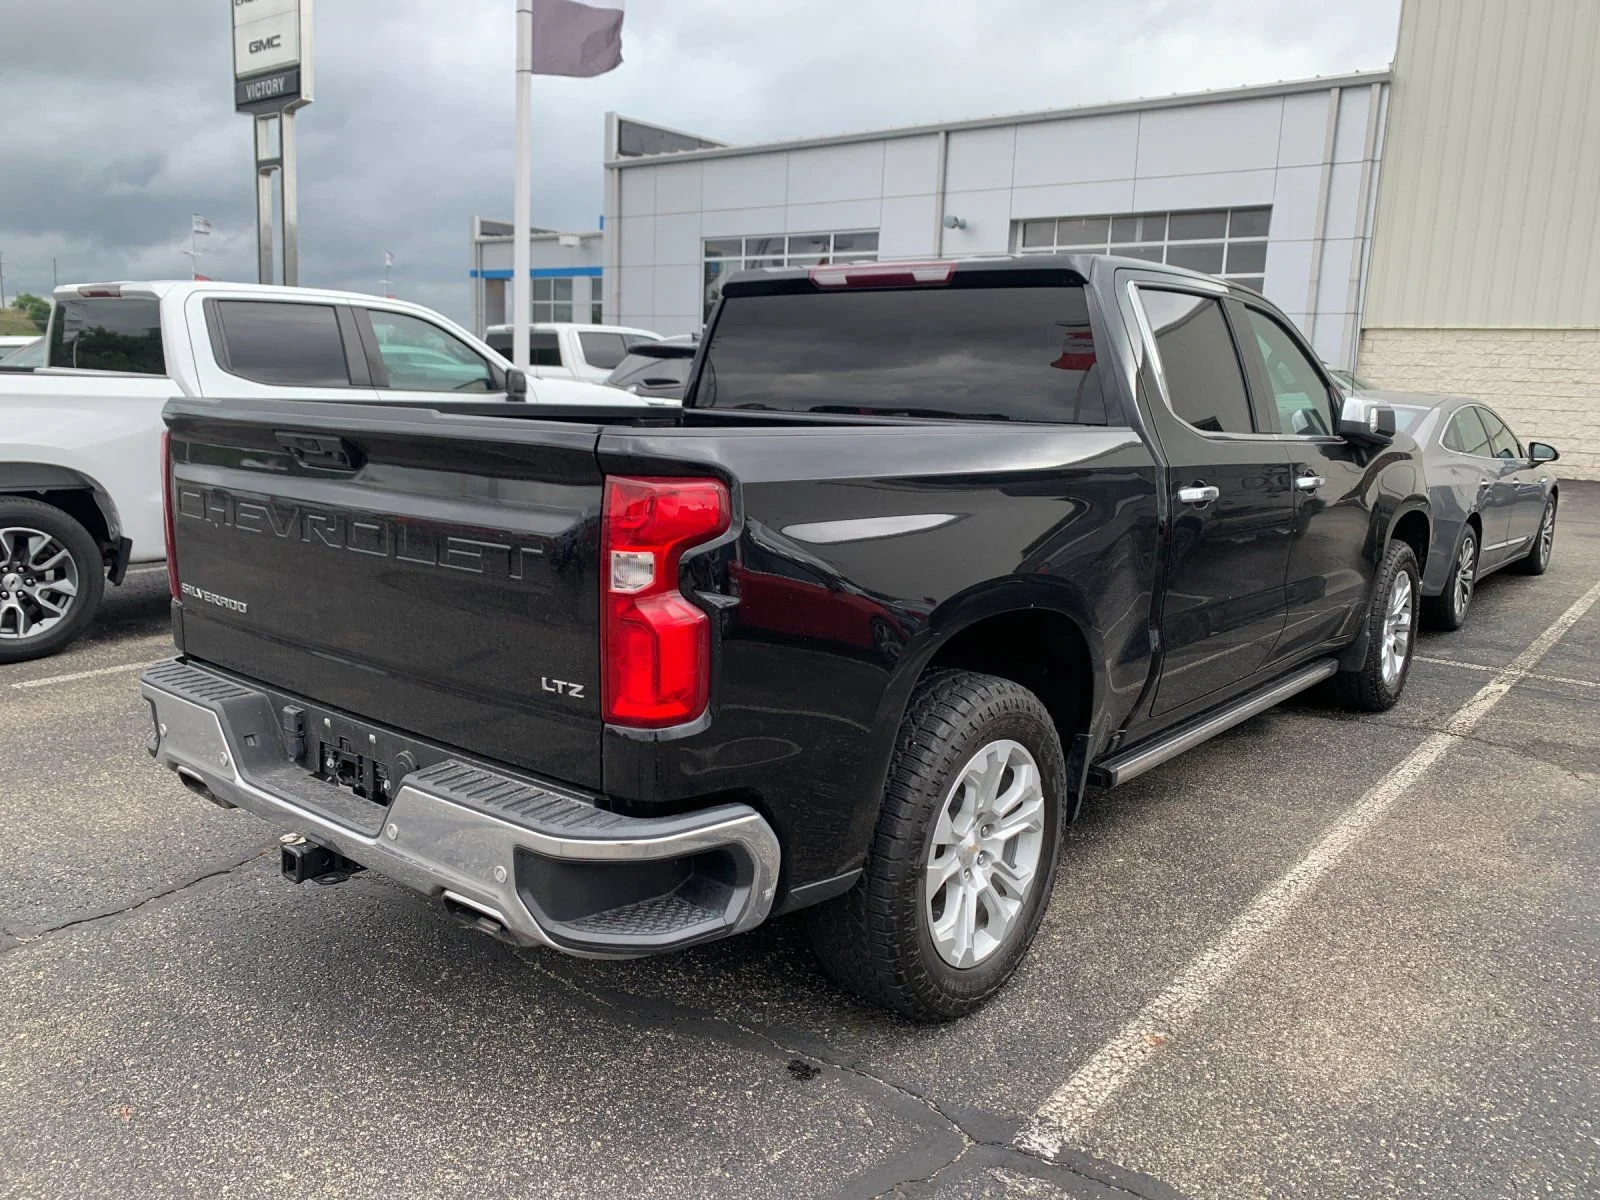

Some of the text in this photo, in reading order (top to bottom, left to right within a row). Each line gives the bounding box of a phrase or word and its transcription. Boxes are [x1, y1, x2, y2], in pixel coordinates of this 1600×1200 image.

[248, 34, 281, 54] GMC
[246, 77, 285, 100] VICTORY
[178, 485, 544, 580] CHEVROLET
[181, 582, 248, 614] SILVERADO
[541, 676, 585, 698] LTZ
